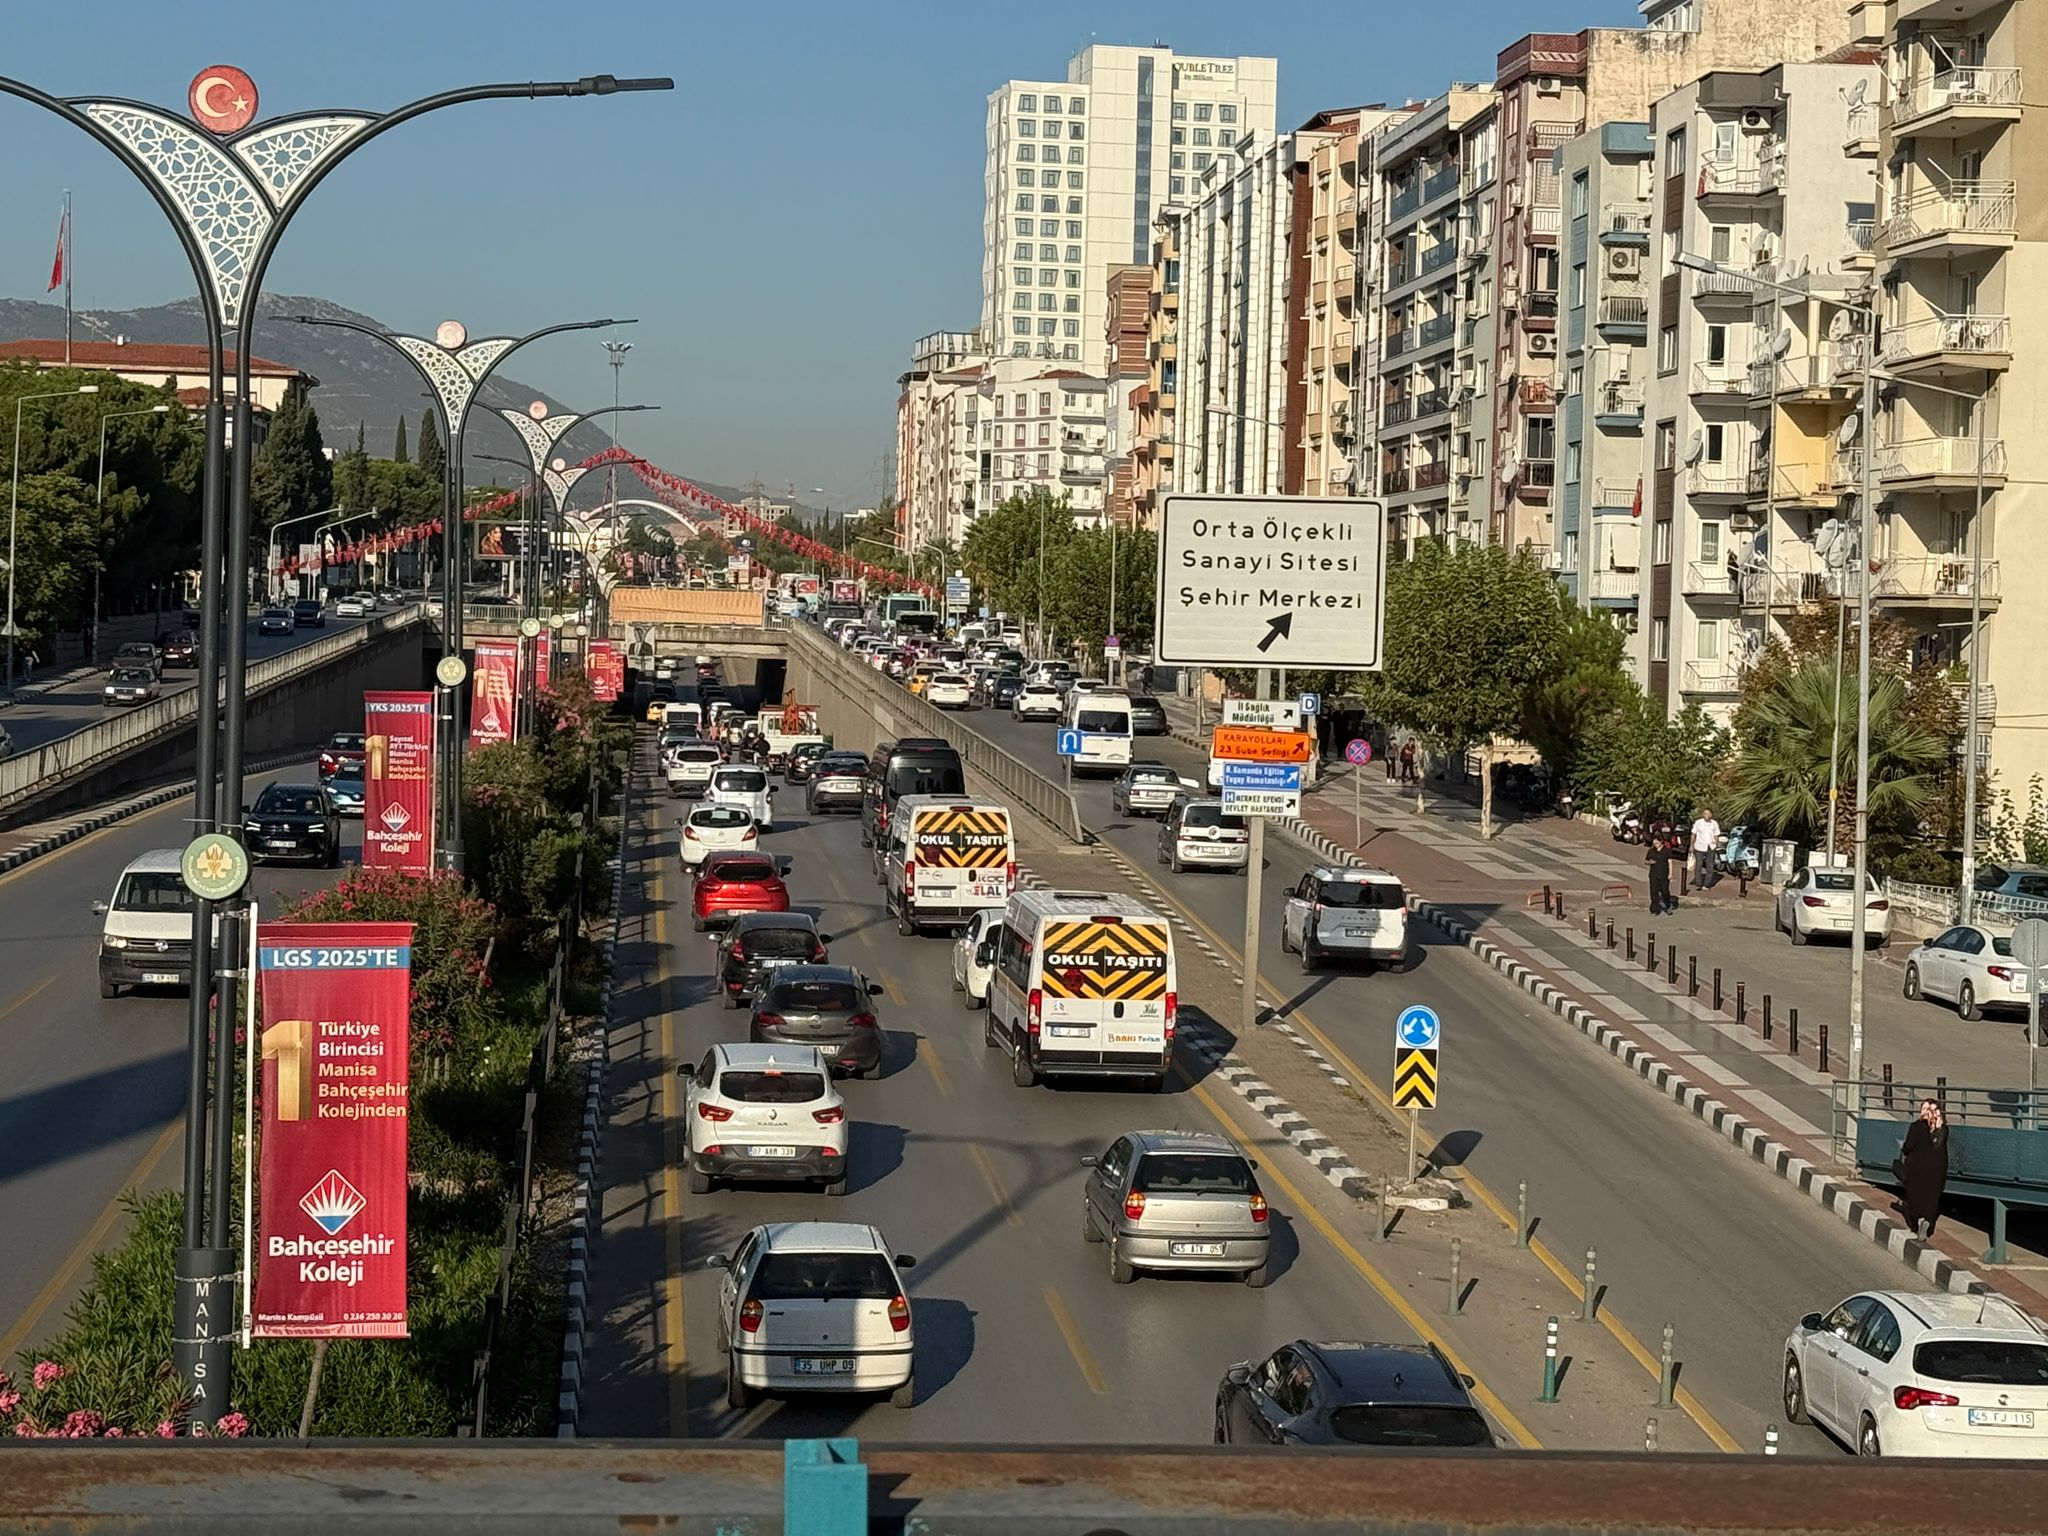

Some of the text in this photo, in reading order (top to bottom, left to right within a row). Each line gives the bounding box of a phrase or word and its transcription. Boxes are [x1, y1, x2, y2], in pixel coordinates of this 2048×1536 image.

[1193, 516, 1352, 542] Orta Ölçekli
[1182, 549, 1358, 574] Sanayi Sitesi
[1180, 586, 1362, 609] Şehir Merkezi
[370, 703, 425, 713] YKS 2025'TE
[1245, 702, 1270, 713] Sağlık
[1232, 713, 1275, 724] Müdürlüğü
[1223, 733, 1287, 746] KARAYOLLARI
[365, 735, 387, 780] 1
[366, 830, 423, 844] Bahçeşehir
[920, 835, 1003, 847] OKUL TAŞITI
[380, 841, 410, 855] Koleji
[273, 948, 398, 967] LGS 2025'TE
[1048, 954, 1163, 969] OKUL TAŞITI
[318, 1021, 381, 1039] Türkiye
[318, 1041, 384, 1057] Birincisi
[261, 1020, 313, 1121] 1
[318, 1061, 378, 1077] Manisa
[318, 1082, 409, 1100] Bahçeşehir
[318, 1103, 407, 1120] Kolejinden
[268, 1233, 395, 1259] Bahçeşehir
[299, 1260, 364, 1287] Koleji
[257, 1312, 325, 1322] Manisa Kampüsü
[801, 1360, 813, 1370] 35
[842, 1359, 854, 1370] 09
